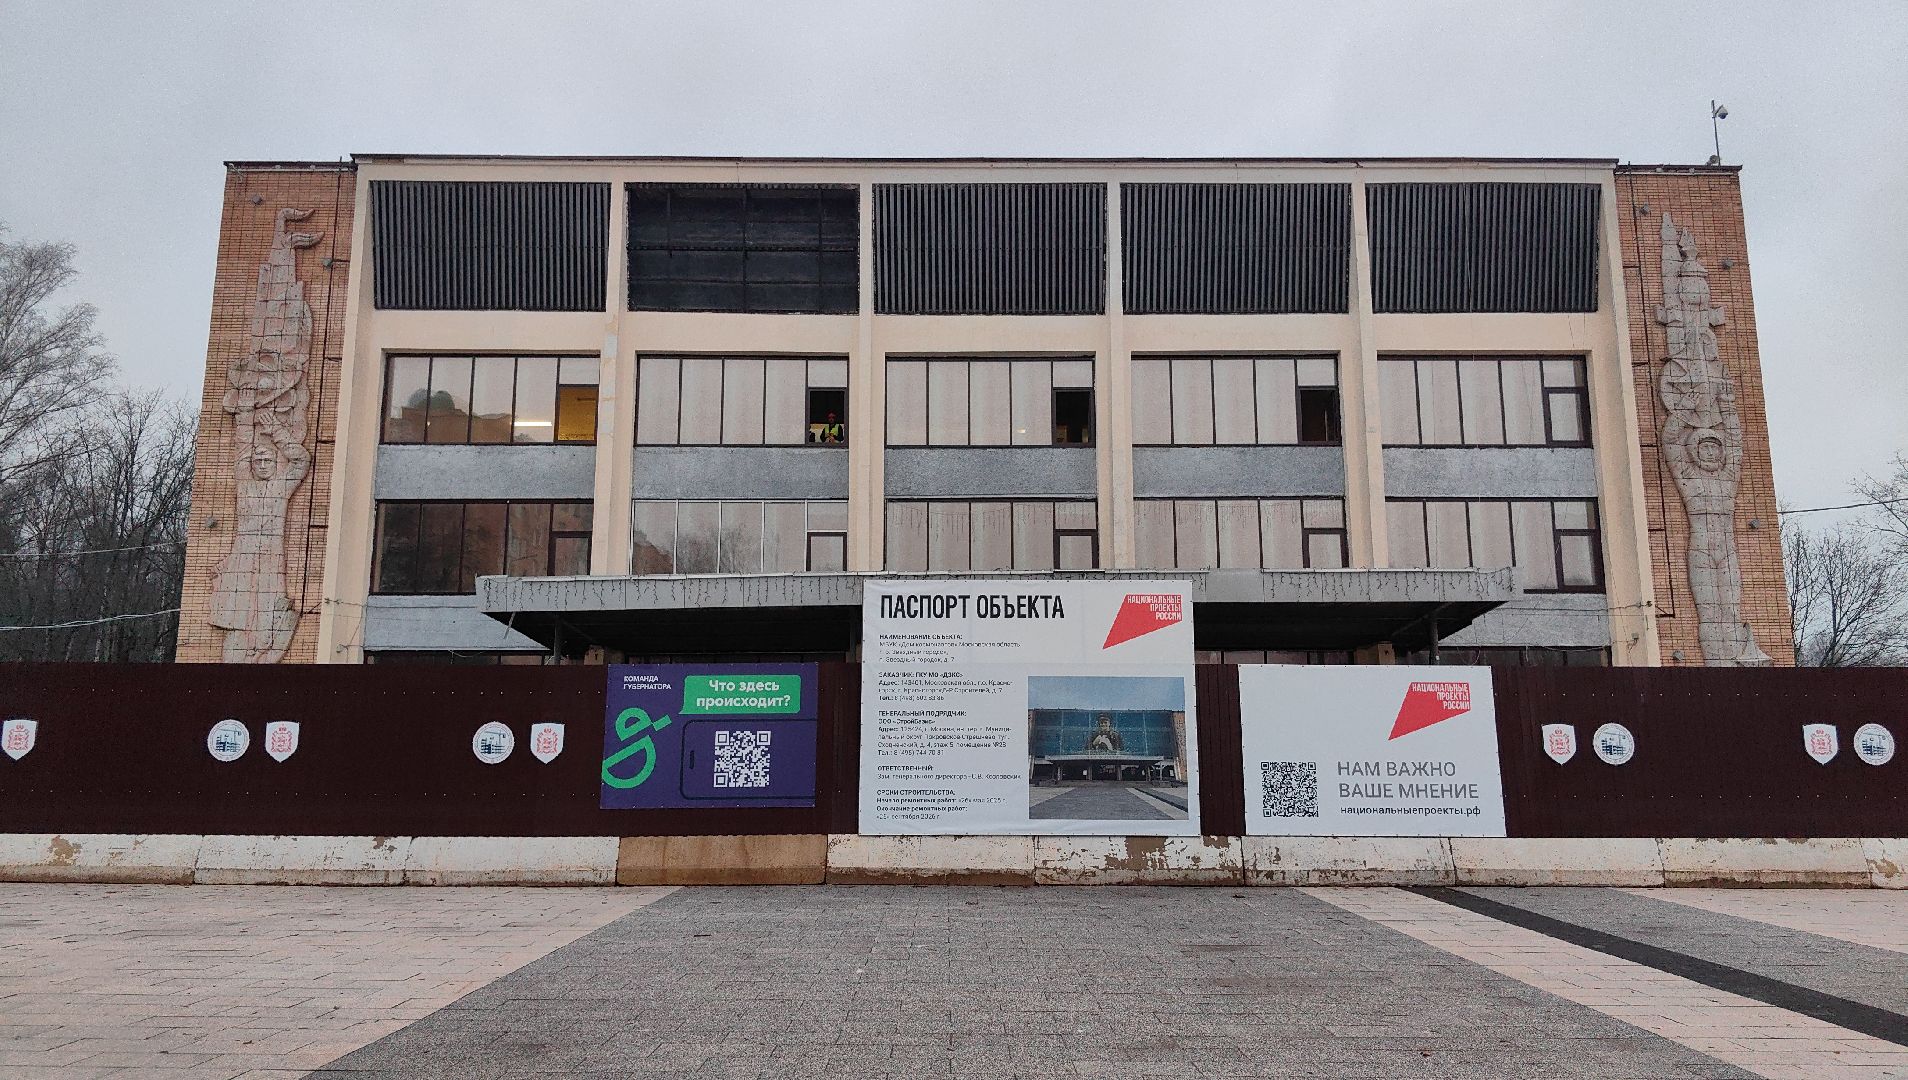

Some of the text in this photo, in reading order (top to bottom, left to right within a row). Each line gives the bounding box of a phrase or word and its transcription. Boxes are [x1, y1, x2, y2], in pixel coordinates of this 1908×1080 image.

[1127, 595, 1181, 604] НАЦИОНАЛЬНЫЕ
[880, 594, 1065, 619] ПАСПОРТ ОБЪЕКТА
[1150, 604, 1181, 612] ПРОЕКТЫ
[1156, 612, 1182, 621] РОССИИ
[623, 675, 659, 683] КОМАНДА
[709, 679, 780, 693] Что здесь
[1412, 683, 1469, 692] НАЦИОНАЛЬНЫЕ
[1436, 692, 1469, 701] ПРОЕКТЫ
[696, 695, 791, 710] происходит?
[1443, 701, 1470, 710] РОССИИ
[1337, 761, 1456, 777] НАМ ВАЖНО
[1339, 783, 1479, 798] ВАШЕ МНЕНИЕ
[1340, 805, 1481, 817] национальныепроекты.рф
